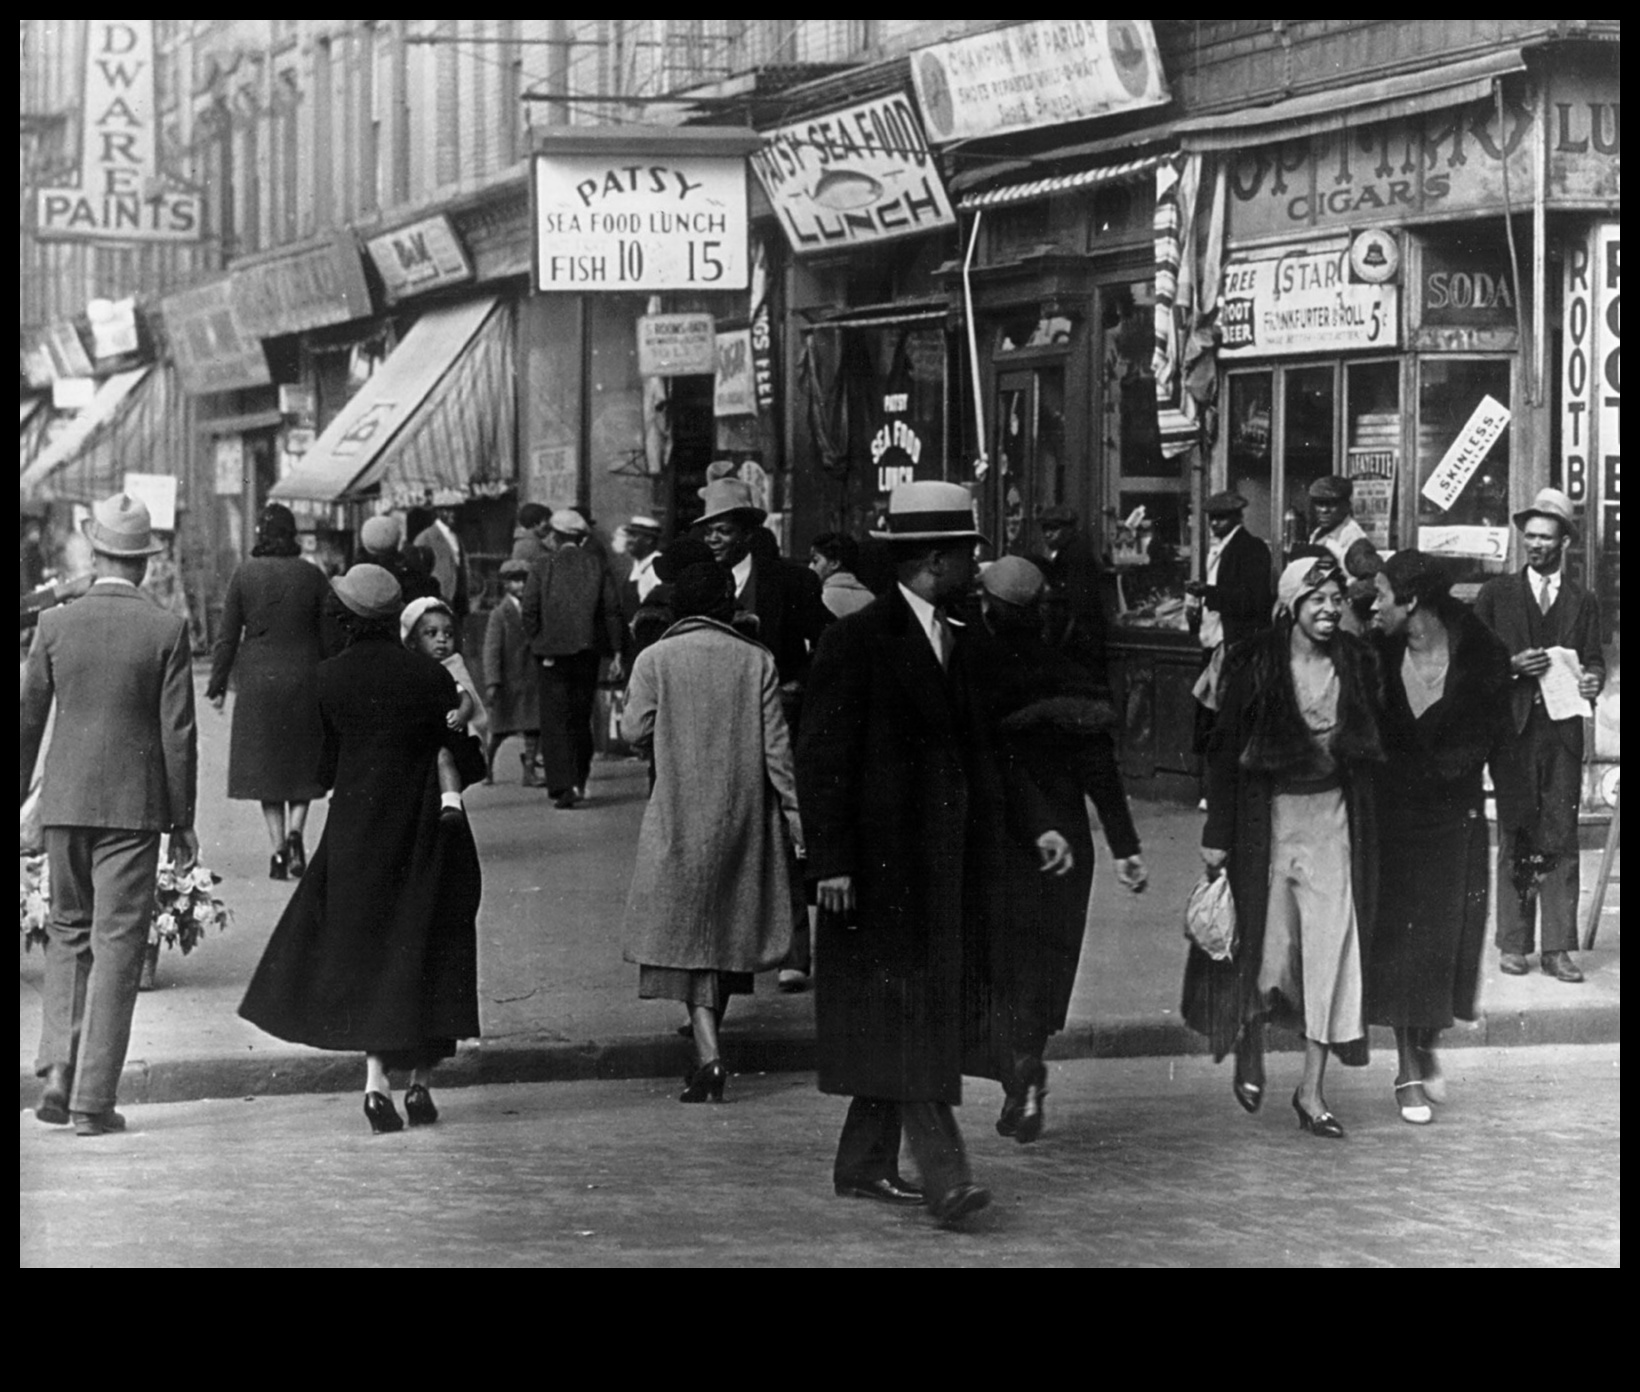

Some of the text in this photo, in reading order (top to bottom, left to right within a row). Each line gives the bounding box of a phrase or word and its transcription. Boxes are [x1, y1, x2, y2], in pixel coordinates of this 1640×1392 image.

[95, 26, 147, 196] DWARE
[808, 117, 864, 165] SEA
[853, 100, 929, 168] FOOD
[576, 166, 703, 207] PATSY
[1287, 173, 1451, 221] CIGARS
[44, 196, 195, 231] PAINTS
[546, 212, 727, 234] SEA FOOD LUNCH
[783, 176, 942, 243] LUNCH
[551, 239, 724, 282] FISH 10 15
[1281, 260, 1338, 294] STAR
[1426, 271, 1513, 310] SODA
[1568, 240, 1588, 446] ROOT
[1439, 416, 1495, 491] SKINLESS
